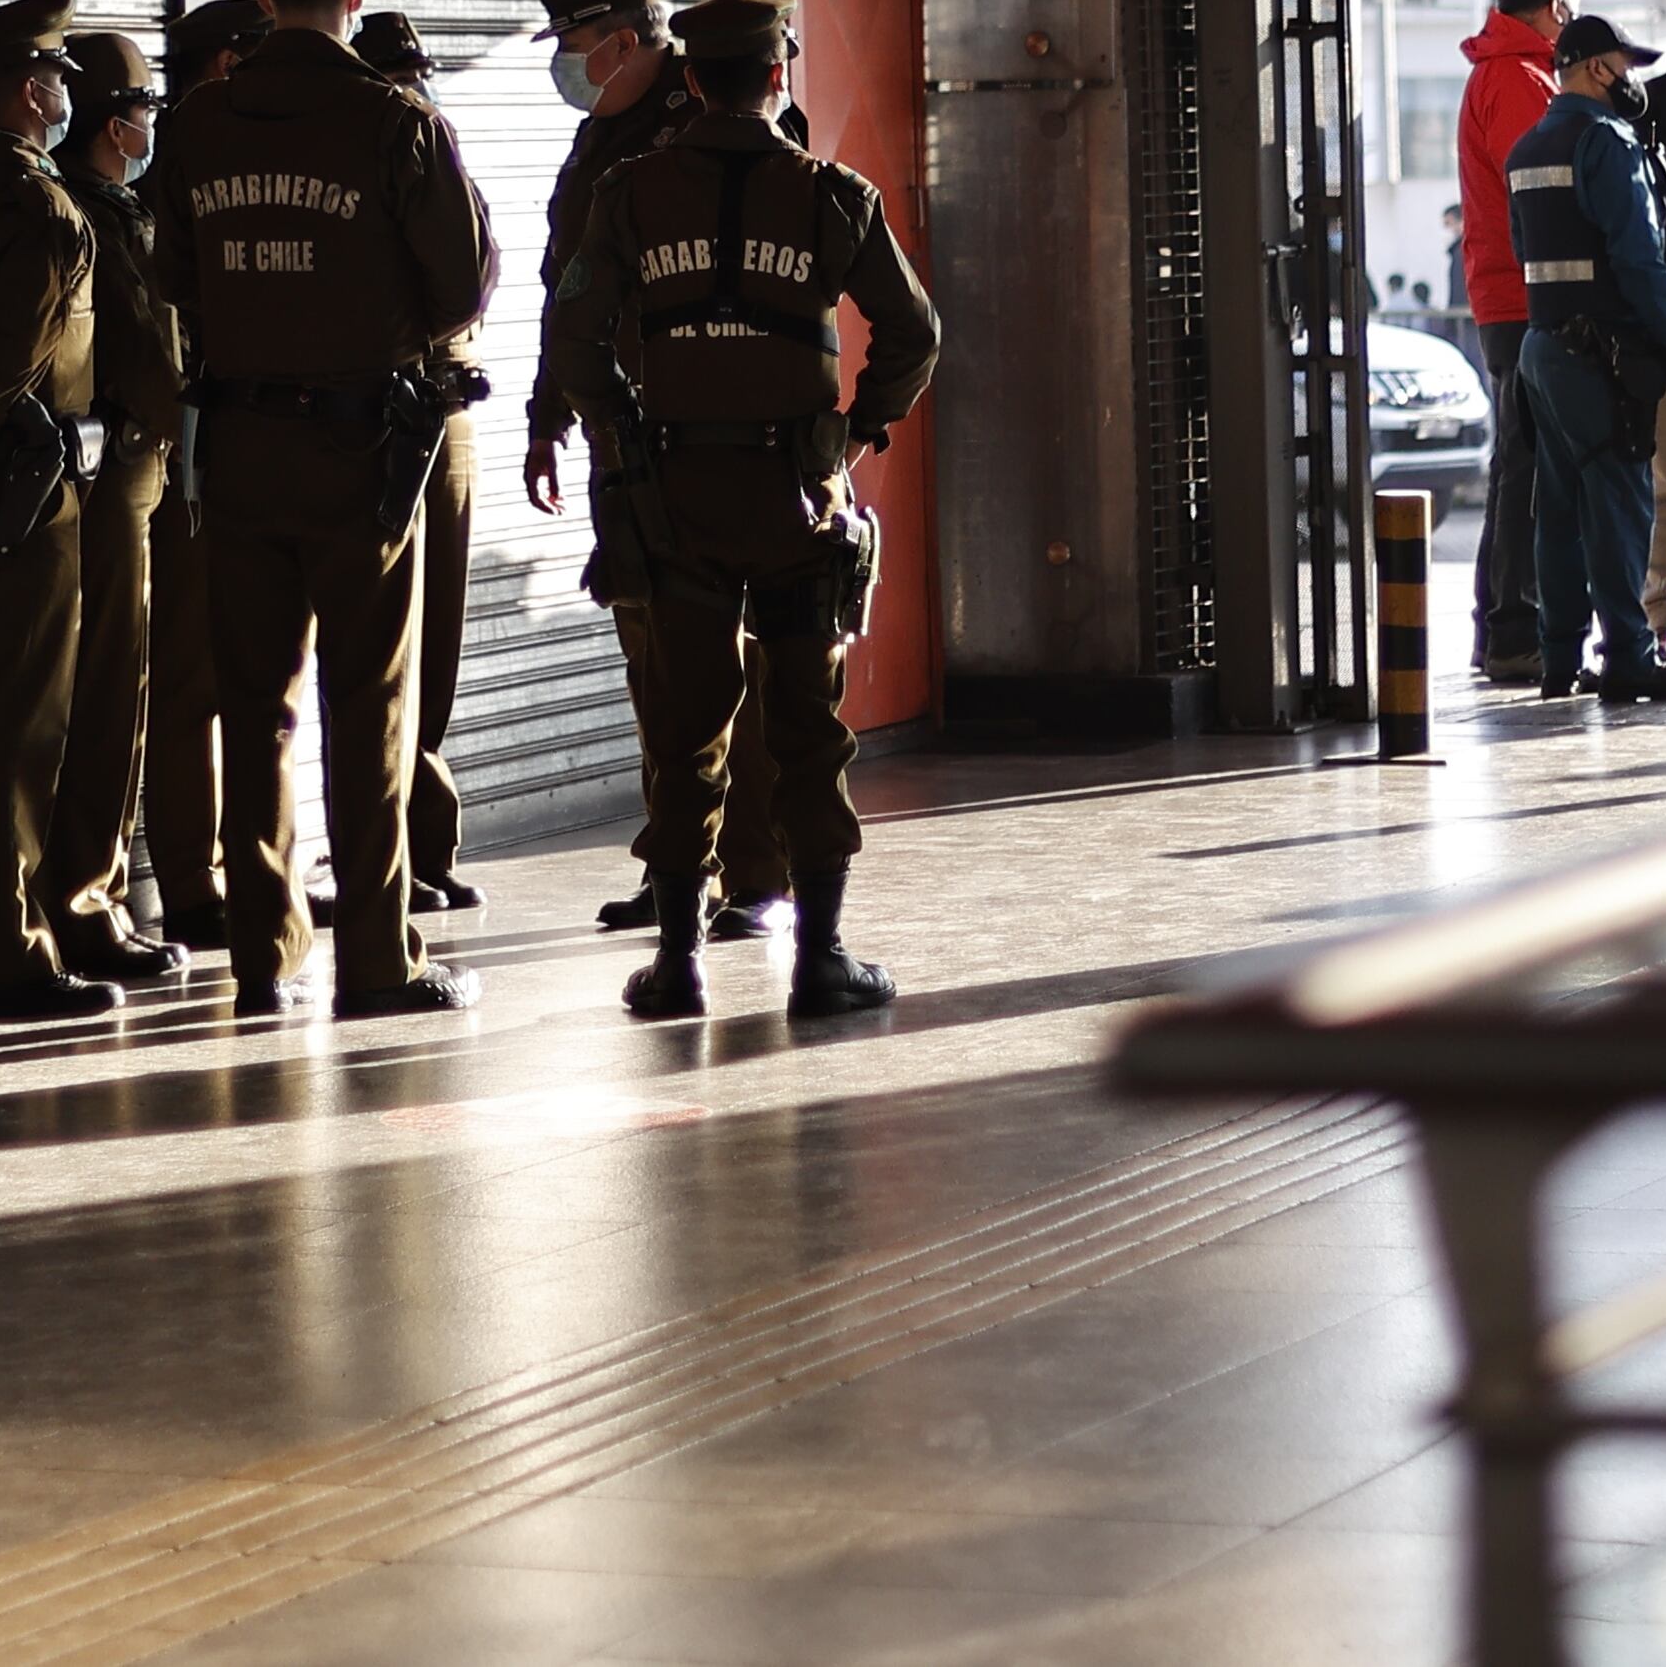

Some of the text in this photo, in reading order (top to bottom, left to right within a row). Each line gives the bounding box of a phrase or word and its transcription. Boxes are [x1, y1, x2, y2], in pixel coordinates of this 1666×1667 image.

[191, 174, 362, 220] CARABINEROS
[223, 240, 315, 272] DE CHILE
[640, 237, 814, 285] CARABEROS
